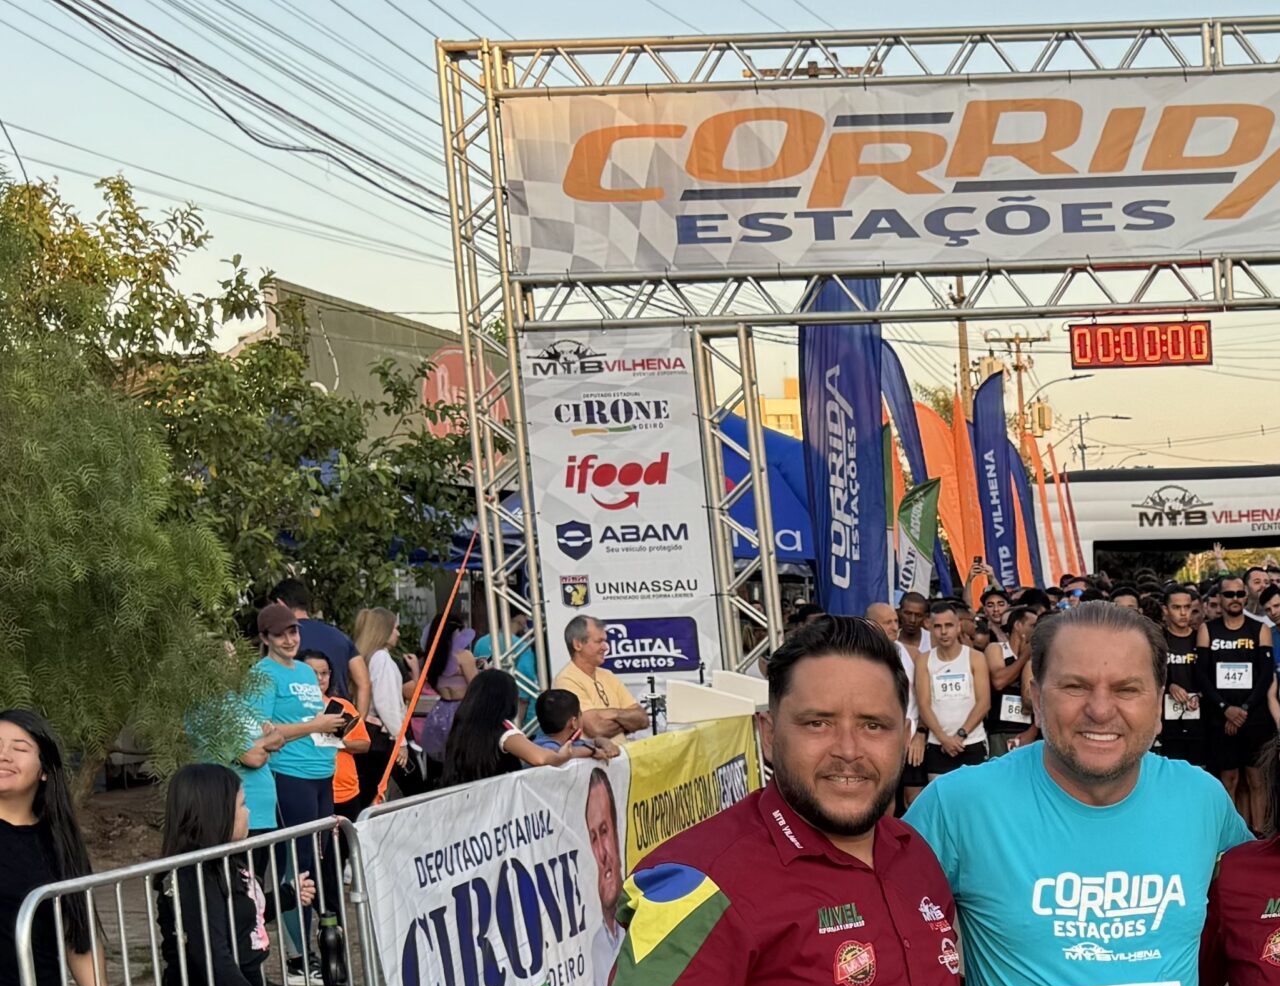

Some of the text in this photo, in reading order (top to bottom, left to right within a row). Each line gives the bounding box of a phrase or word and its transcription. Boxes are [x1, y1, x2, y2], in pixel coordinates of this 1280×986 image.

[675, 196, 1175, 247] ESTAÇÕES
[1073, 324, 1208, 363] 00:00:00
[554, 399, 670, 425] CIRONE
[564, 451, 670, 494] ifood
[825, 364, 854, 590] CORRIDA
[845, 424, 861, 561] ESTAÇÕES
[983, 449, 1005, 538] VILHENA
[599, 522, 689, 544] ABAM
[900, 546, 917, 593] RONE
[595, 578, 699, 595] UNINASSAU
[1210, 638, 1254, 651] StarFit
[613, 656, 675, 669] eventos
[1224, 672, 1243, 681] 447
[941, 681, 962, 692] 916
[413, 808, 554, 889] DEPUTADO ESTADUAL
[817, 902, 863, 929] NIVEL
[1031, 870, 1186, 931] CORRIDA
[1053, 917, 1147, 944] ESTAÇÕES
